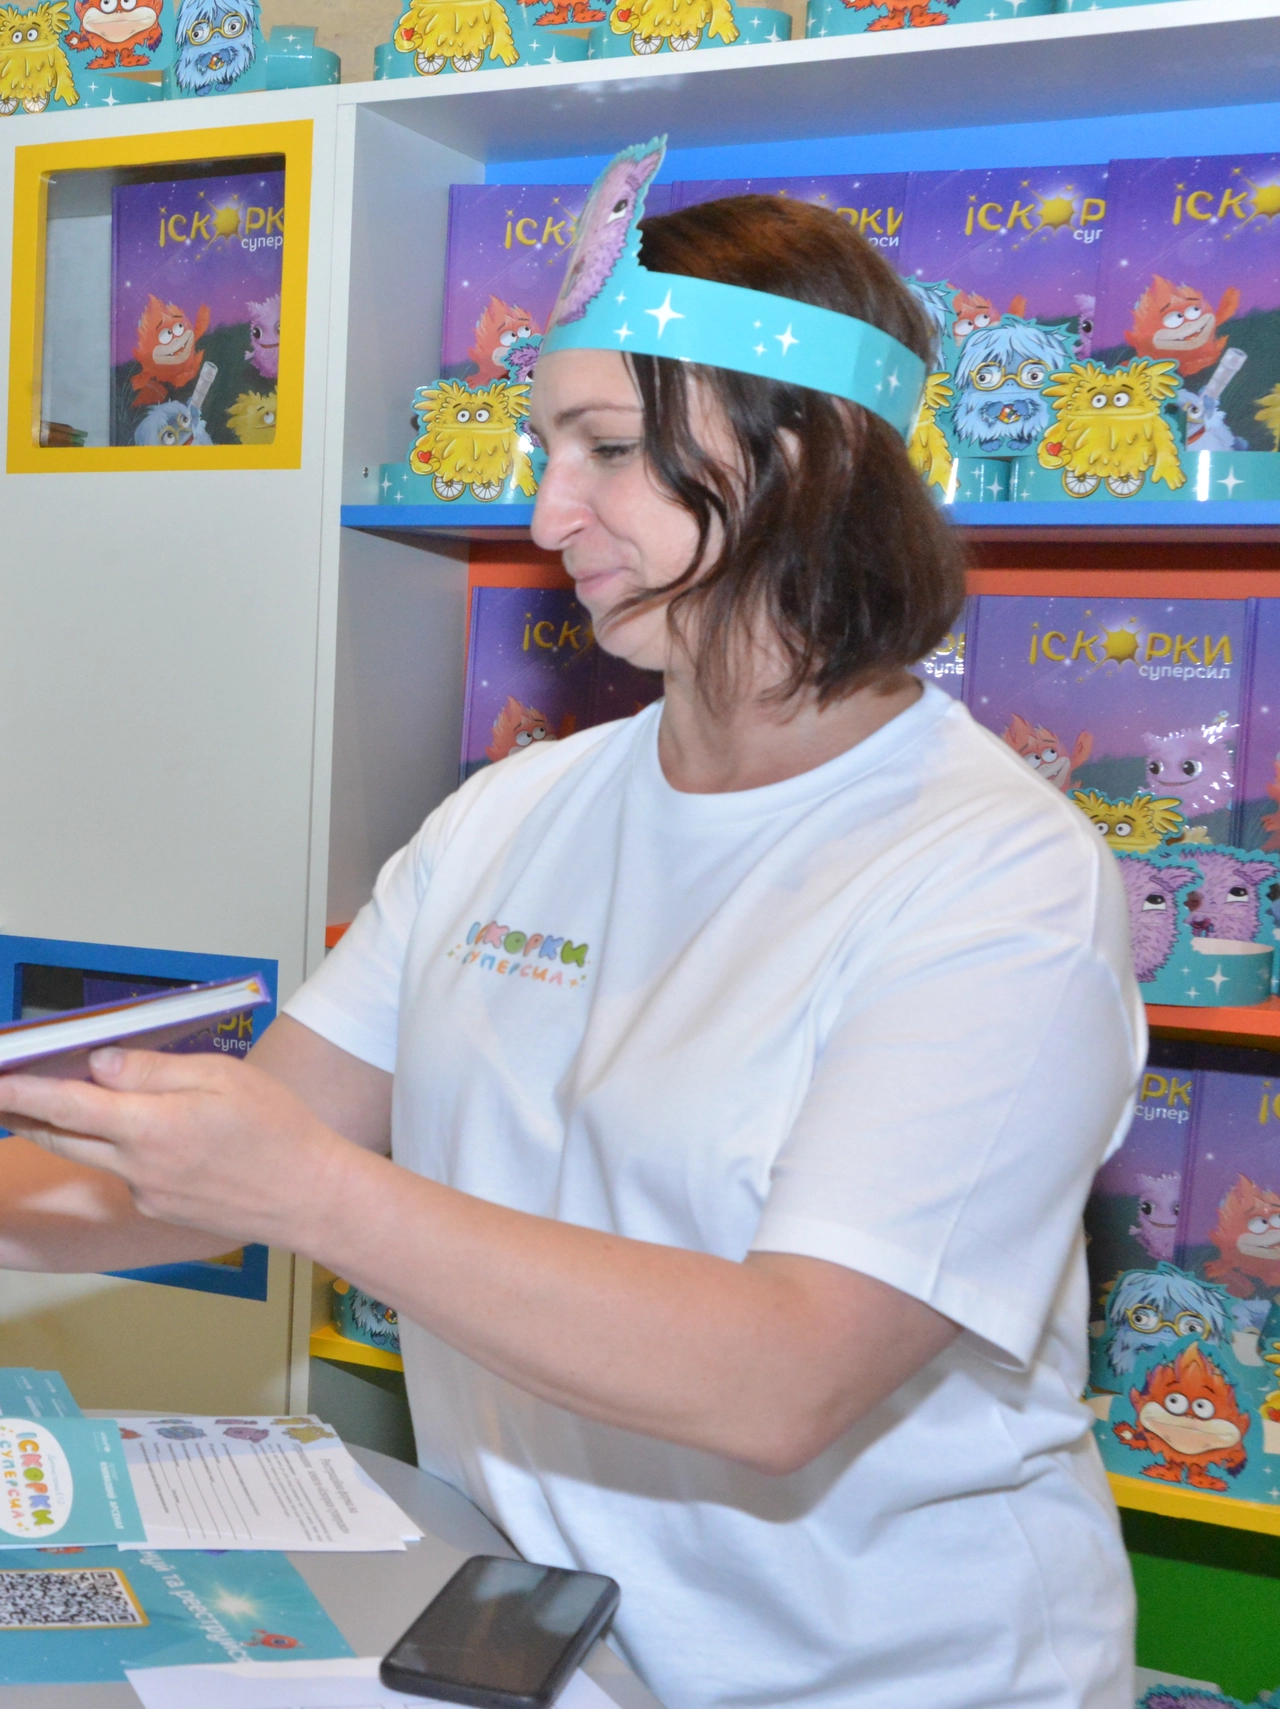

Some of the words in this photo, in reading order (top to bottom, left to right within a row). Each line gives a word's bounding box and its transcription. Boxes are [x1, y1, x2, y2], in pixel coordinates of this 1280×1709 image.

[241, 235, 283, 252] супер
[1028, 622, 1233, 667] ІСКОРКИ
[1139, 663, 1231, 681] суперсил
[15, 1431, 55, 1527] ІСКОРКИ
[161, 1574, 186, 1589] та
